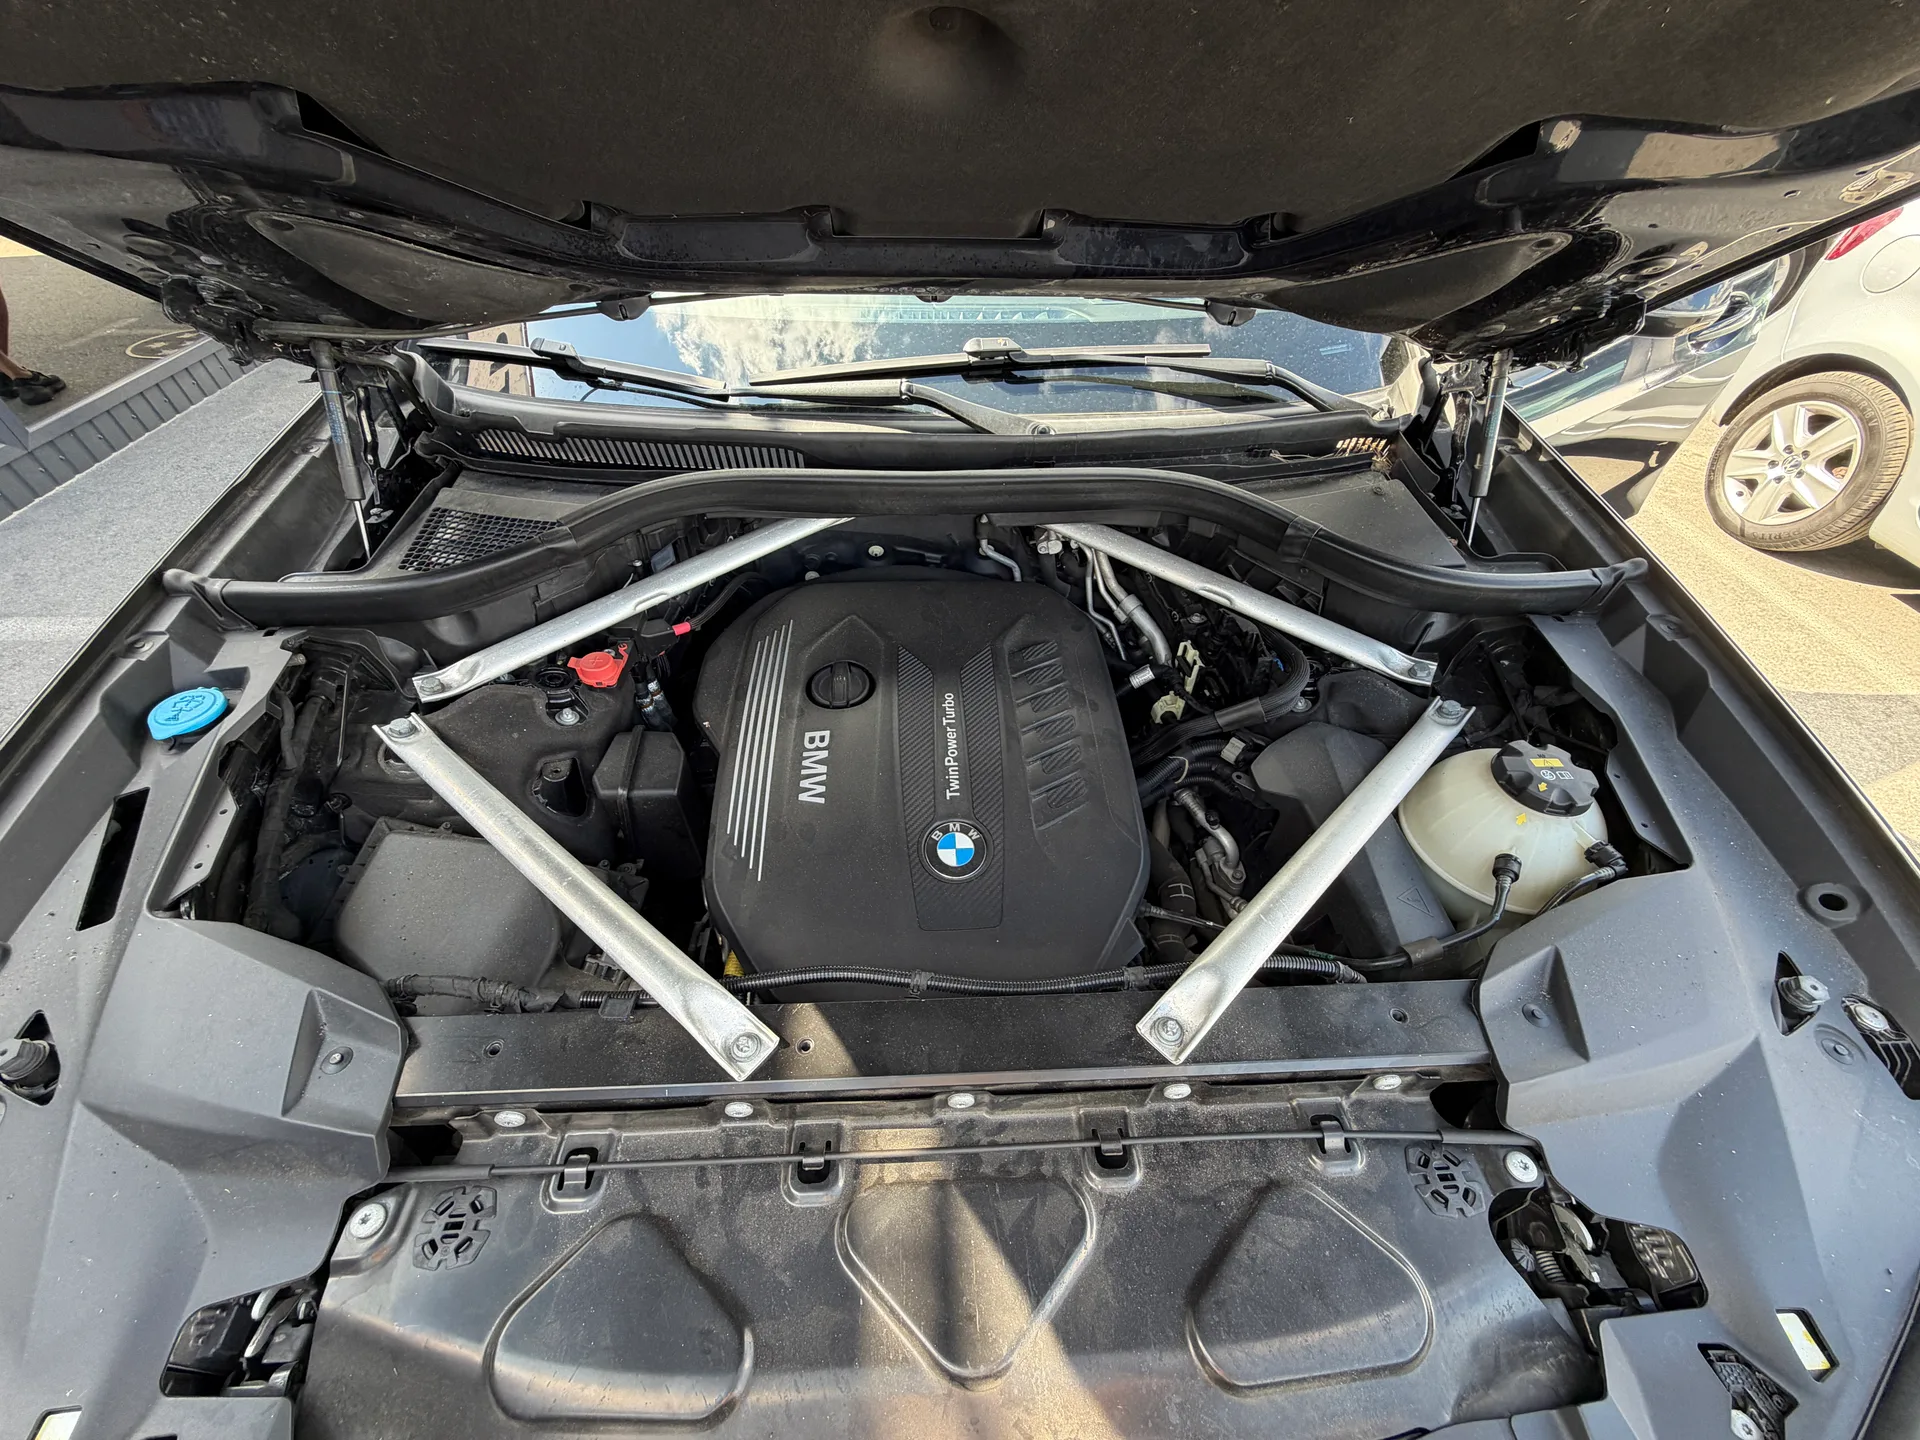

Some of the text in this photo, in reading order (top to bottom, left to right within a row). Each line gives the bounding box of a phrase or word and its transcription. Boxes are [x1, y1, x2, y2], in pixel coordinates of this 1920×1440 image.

[798, 730, 831, 804] BMW
[942, 692, 960, 800] TwinPower Turbo
[931, 822, 980, 841] BMW
